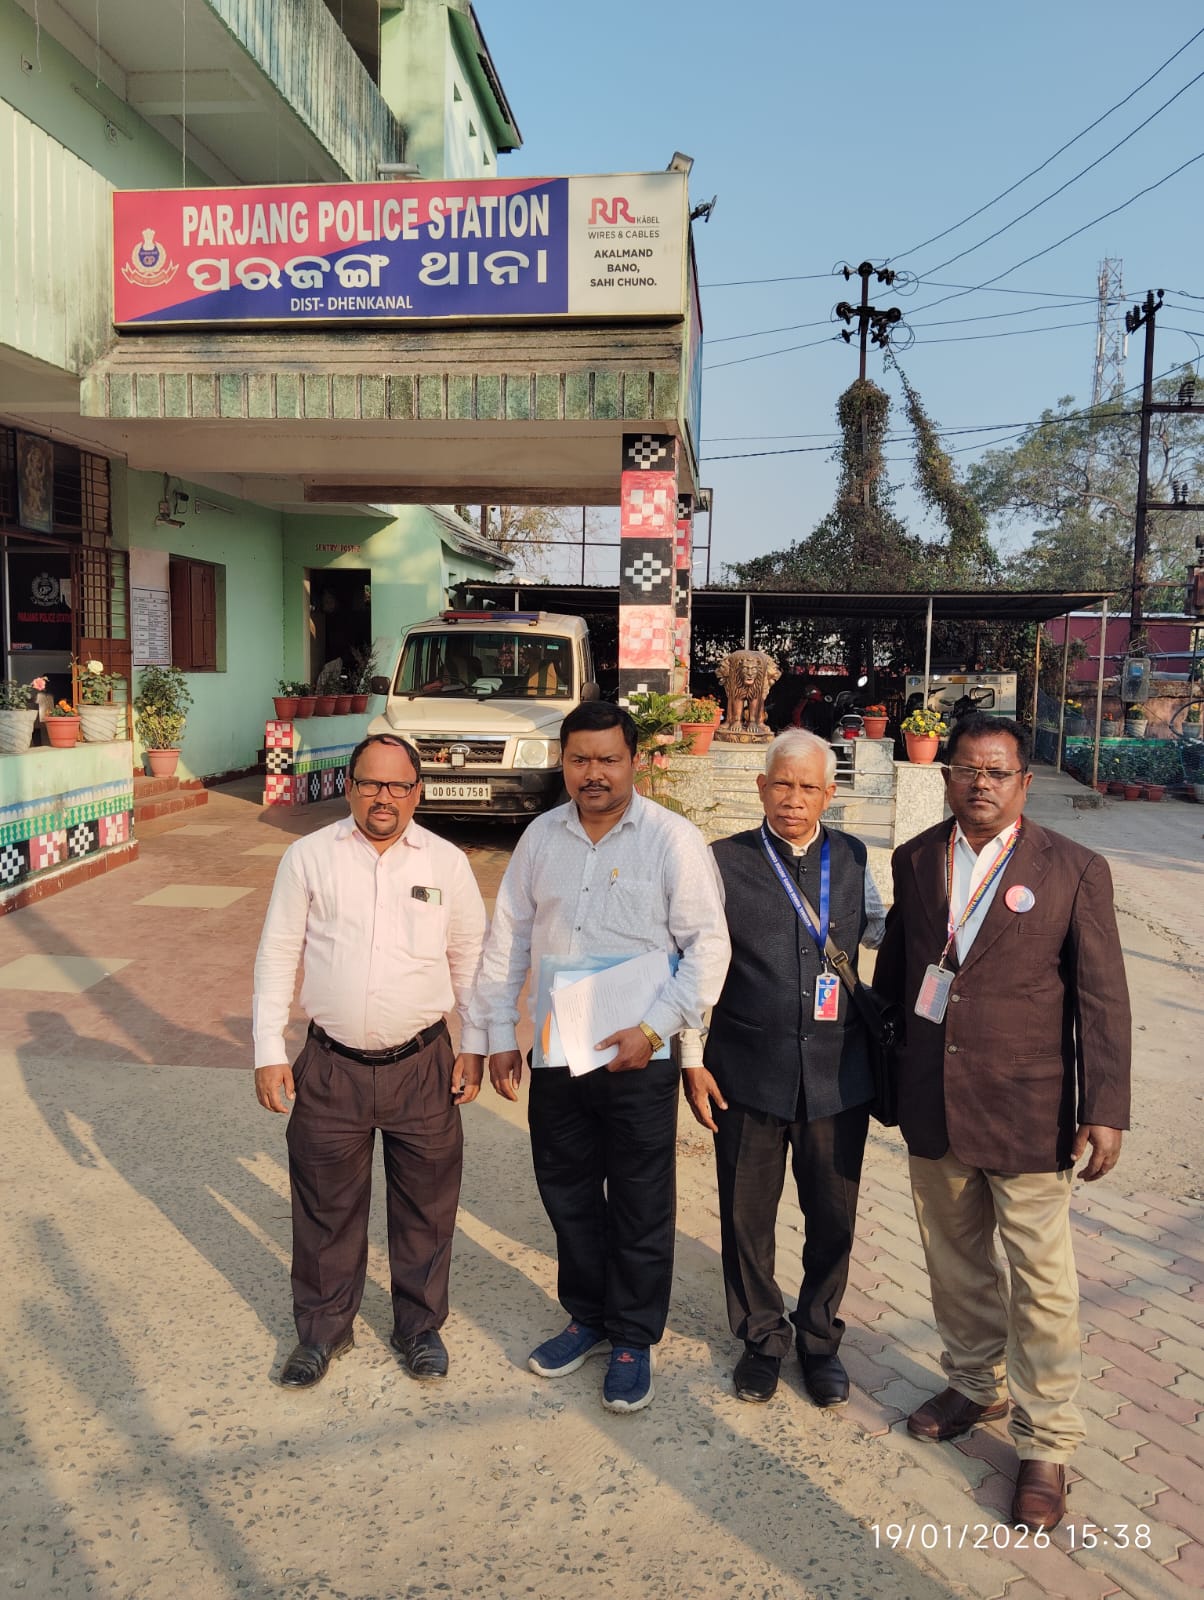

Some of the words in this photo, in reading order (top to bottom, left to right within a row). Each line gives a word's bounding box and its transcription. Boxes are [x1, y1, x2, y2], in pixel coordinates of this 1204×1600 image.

[182, 201, 309, 247] PARJANG
[318, 197, 419, 242] POLICE
[428, 193, 549, 240] STATION
[588, 231, 615, 239] WIRES
[626, 230, 660, 238] CABLES
[594, 248, 653, 258] AKALMAND
[607, 263, 640, 273] BANO,
[590, 278, 615, 287] SAHI
[617, 277, 657, 287] CHUNO.
[290, 297, 325, 312] DIST-
[328, 295, 413, 311] DHENKANAL
[466, 787, 489, 797] 7581
